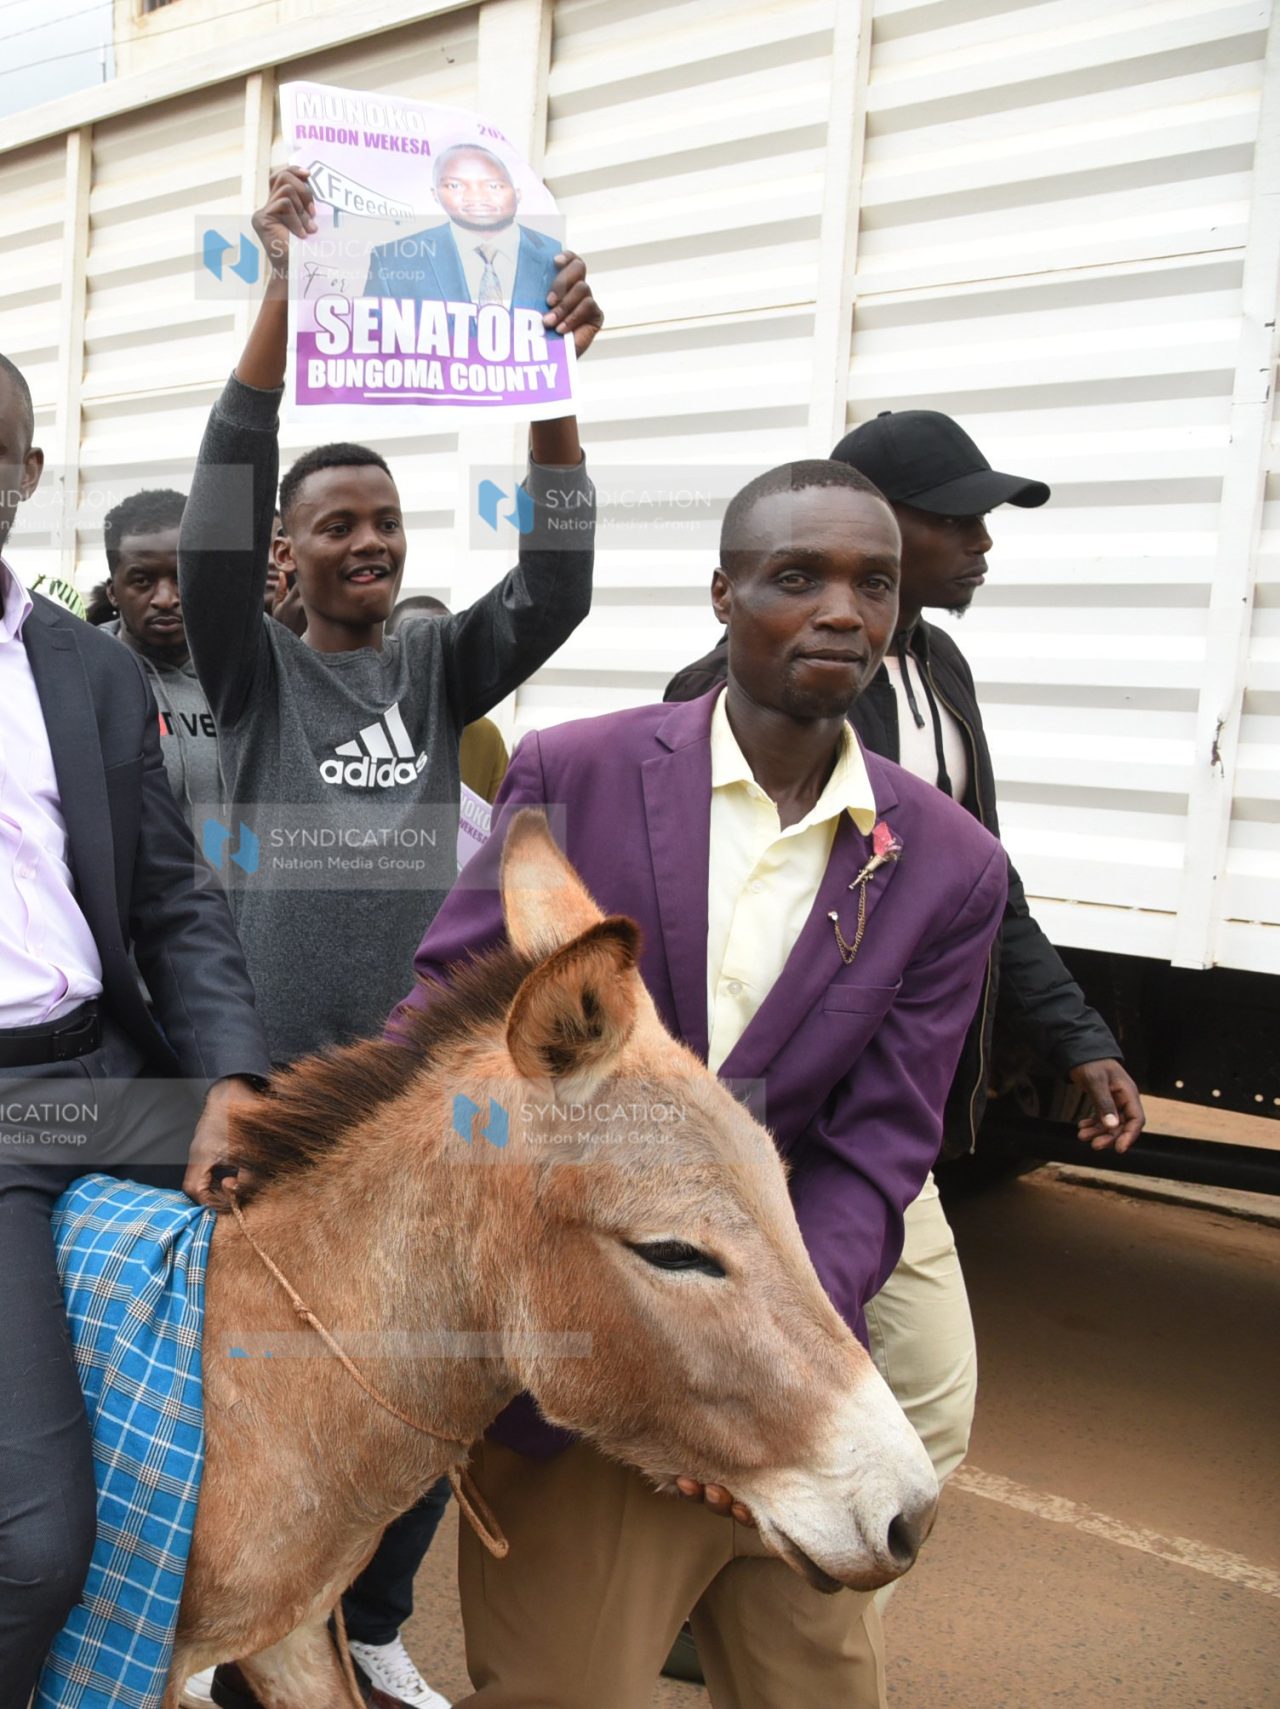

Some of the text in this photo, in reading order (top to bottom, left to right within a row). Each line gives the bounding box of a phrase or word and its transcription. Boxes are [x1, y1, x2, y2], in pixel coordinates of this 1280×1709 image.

[295, 91, 426, 133] MUNOKO
[295, 124, 431, 156] RAIDON WEKESA
[327, 172, 413, 219] Freedom
[314, 293, 549, 362] SENATOR
[307, 357, 558, 392] BUNGOMA COUNTY
[320, 751, 427, 788] adidas
